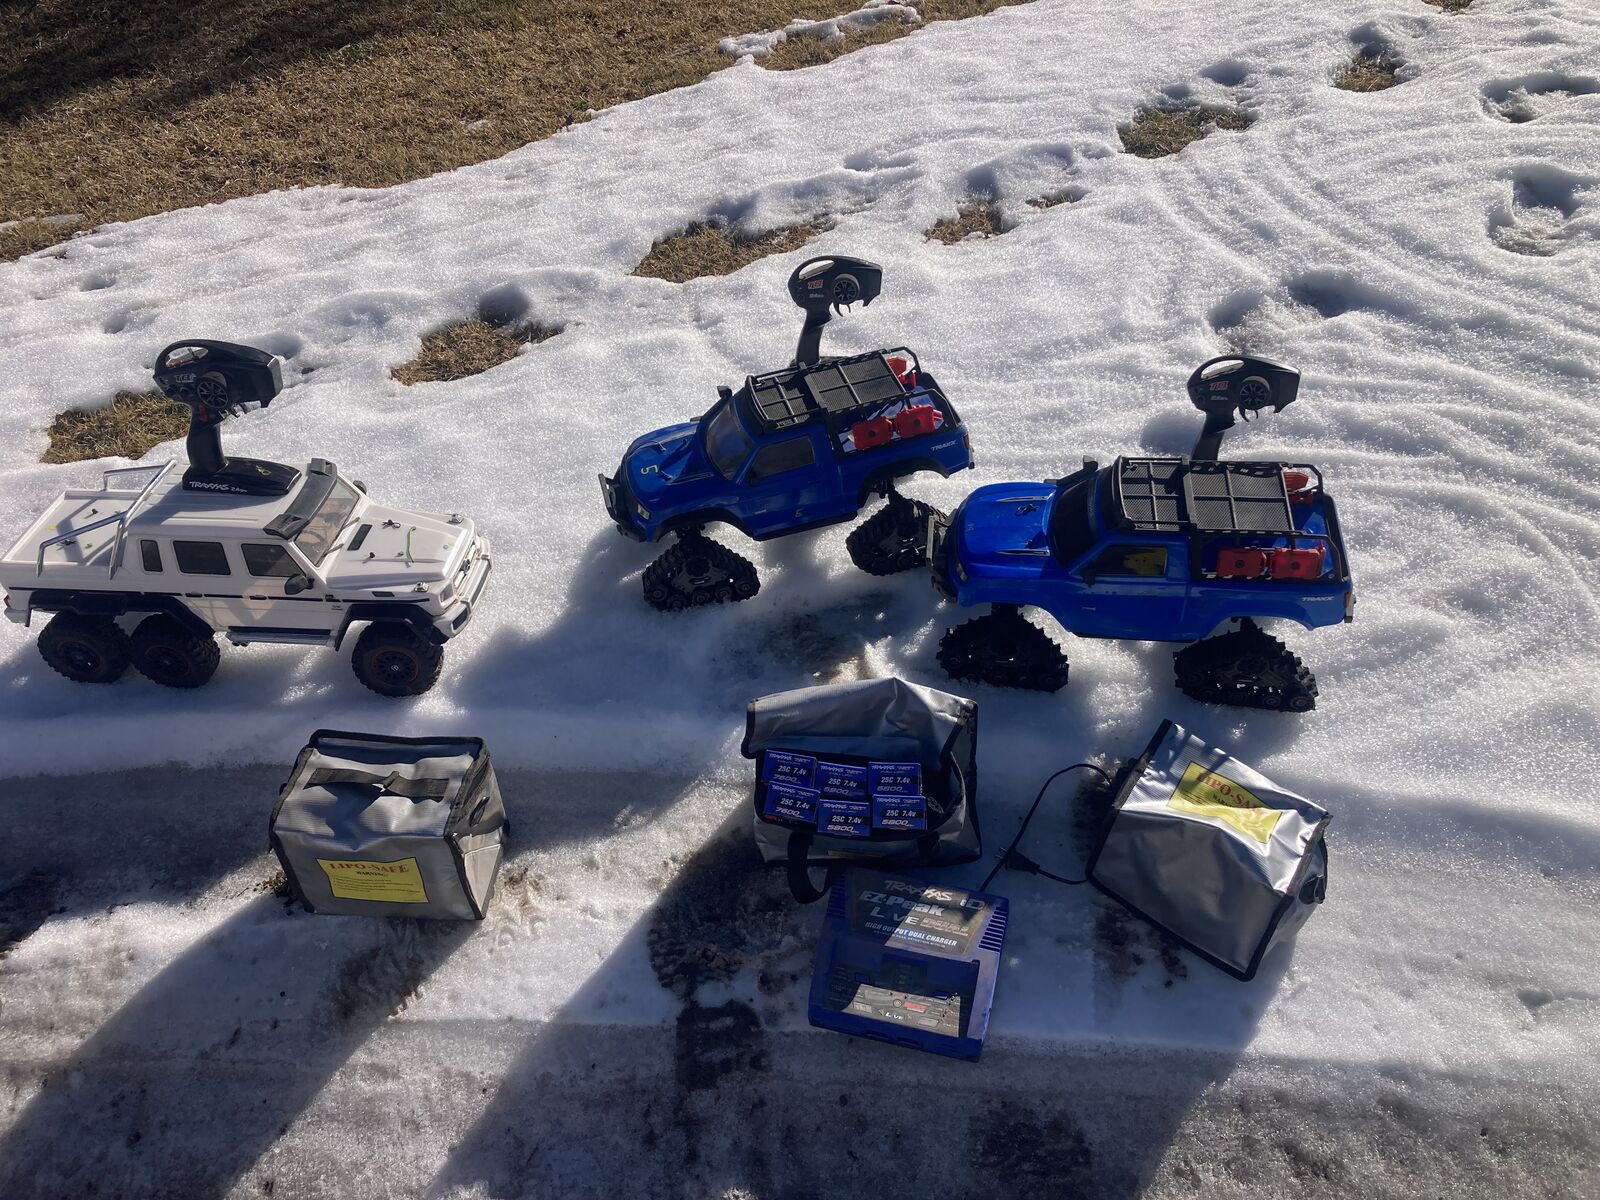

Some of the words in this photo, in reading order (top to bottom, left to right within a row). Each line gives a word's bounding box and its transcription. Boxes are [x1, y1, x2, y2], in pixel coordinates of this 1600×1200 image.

[640, 464, 658, 475] 5
[189, 481, 229, 490] TRAXXAS
[778, 765, 791, 773] 25C
[828, 777, 841, 785] 25C
[780, 797, 794, 806] 25C
[831, 815, 845, 823] 25C
[827, 824, 854, 832] 5800
[328, 863, 409, 874] LIPO-SAFE
[884, 880, 953, 901] TRAXXAS
[860, 890, 945, 917] EZ-Peak
[870, 906, 920, 926] LVE
[864, 921, 881, 930] HIGH
[882, 924, 908, 935] OUTPUT
[907, 930, 926, 939] DUAL
[925, 933, 958, 947] CHARGER
